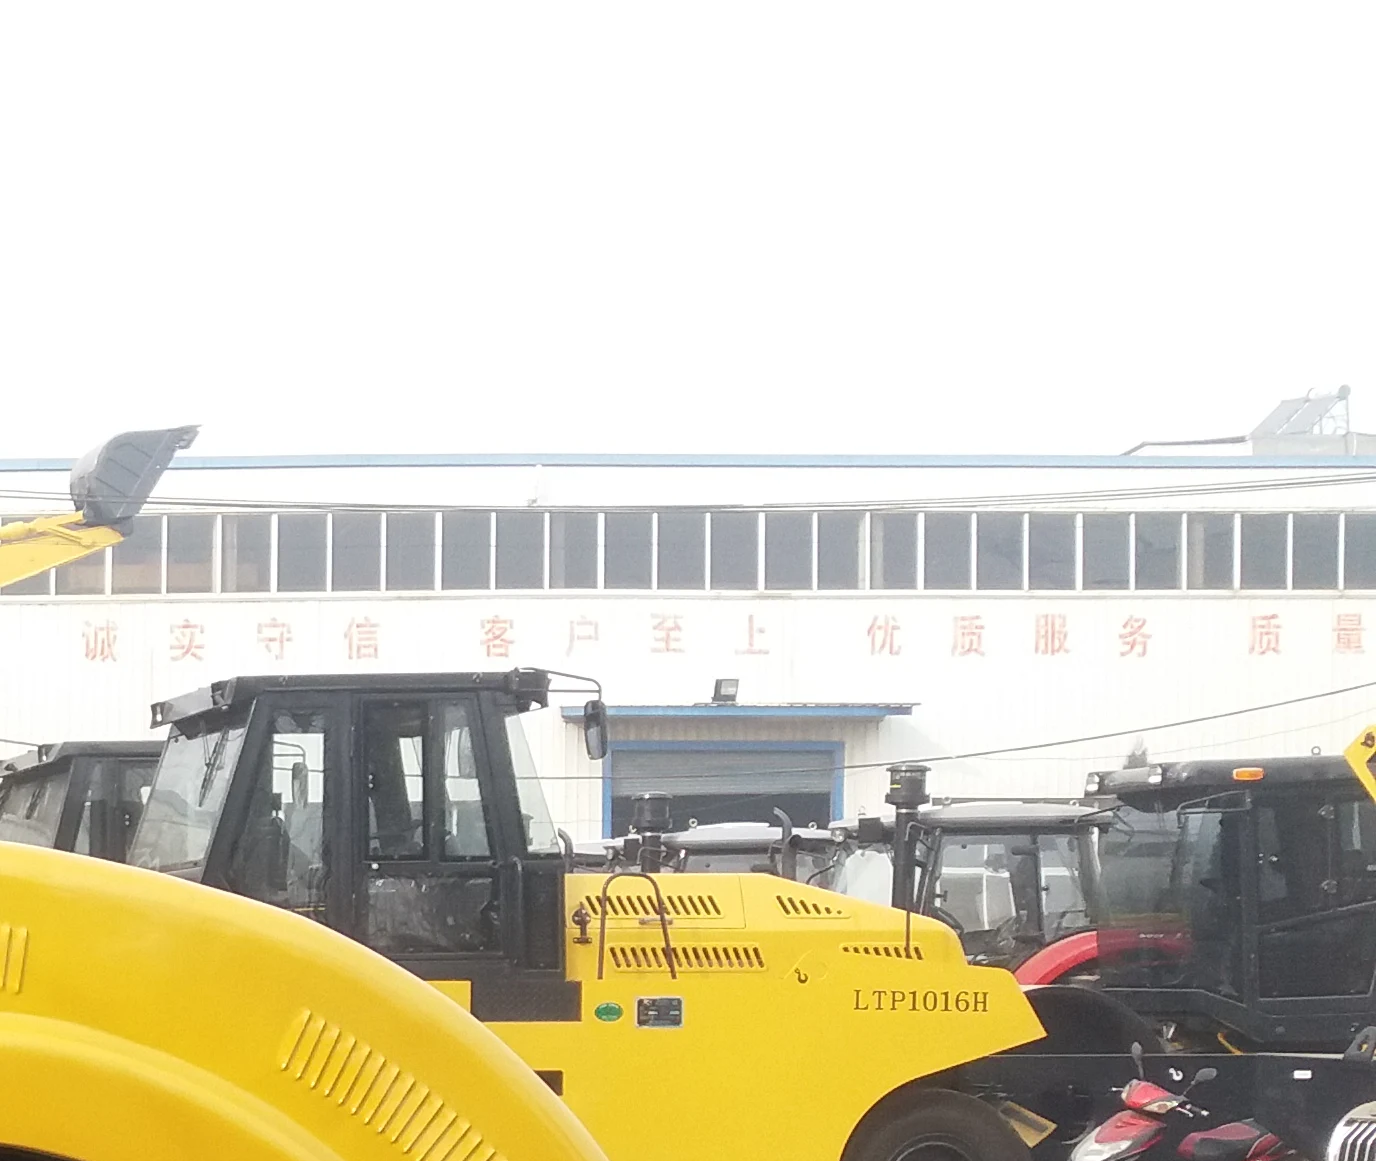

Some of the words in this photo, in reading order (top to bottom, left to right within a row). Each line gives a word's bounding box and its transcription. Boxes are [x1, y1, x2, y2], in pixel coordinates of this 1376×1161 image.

[81, 614, 380, 662] 诚实守信
[479, 613, 770, 658] 客户至上
[866, 612, 1154, 657] 优质服务
[1248, 612, 1367, 656] 质量
[853, 989, 989, 1013] LTP1016H
